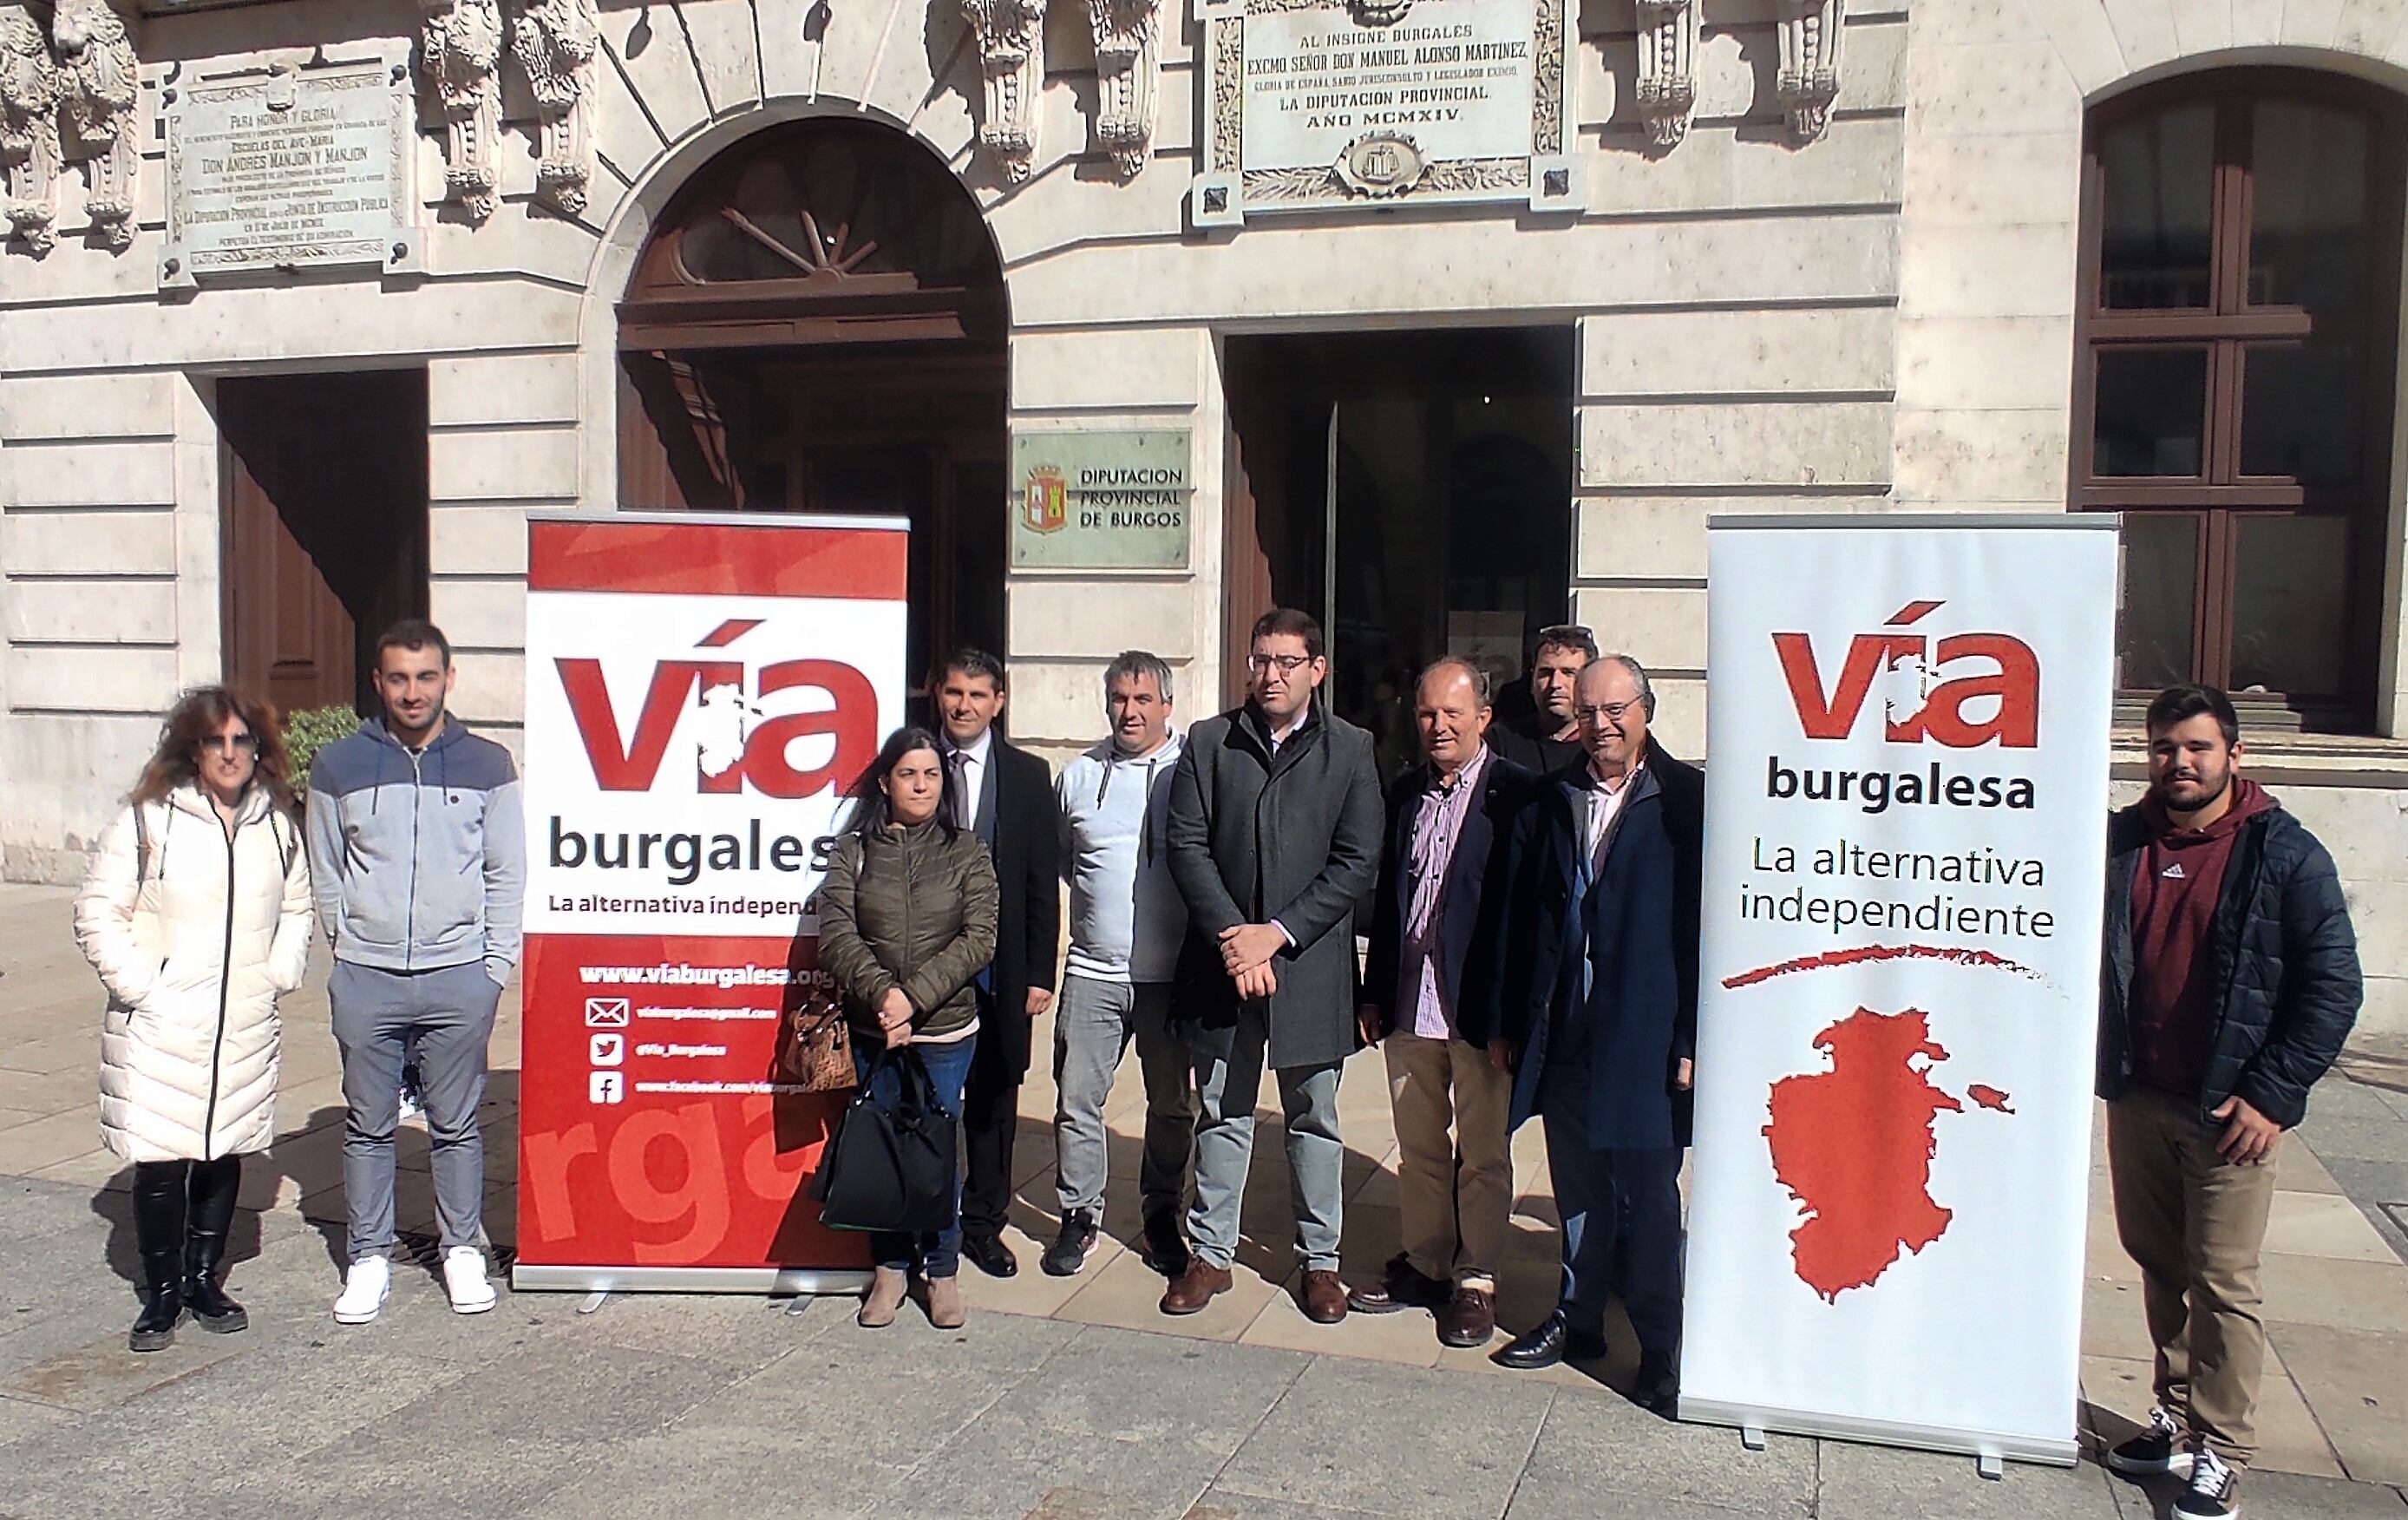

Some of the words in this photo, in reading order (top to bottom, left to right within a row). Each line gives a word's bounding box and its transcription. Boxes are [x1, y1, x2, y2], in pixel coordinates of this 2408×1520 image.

[1300, 35, 1320, 49] AL
[1326, 31, 1386, 47] INSIGNE
[1392, 24, 1472, 42] BURGALES
[1292, 53, 1328, 72] SEÑOR
[1333, 52, 1355, 70] DON
[1360, 48, 1409, 68] MANUEL
[1414, 45, 1460, 64] ALONSO
[1279, 97, 1299, 111] LA
[1306, 90, 1393, 109] DIPUTACION
[1307, 111, 1352, 128] AÑO
[1081, 469, 1181, 484] DIPUTACION
[1080, 490, 1181, 506] PROVINCIAL
[1080, 512, 1102, 527] DE
[1111, 511, 1181, 527] BURGOS
[1771, 599, 2041, 749] vía
[553, 618, 879, 800] vía
[1767, 756, 2035, 814] burgalesa
[548, 816, 839, 885] burgales
[1753, 835, 1796, 872] La
[1813, 839, 2044, 887] alternativa
[549, 894, 574, 912] La
[579, 894, 704, 915] alternativa
[710, 894, 817, 919] independ
[1741, 883, 2054, 939] independiente
[579, 963, 834, 988] www.viaburgalesa.org
